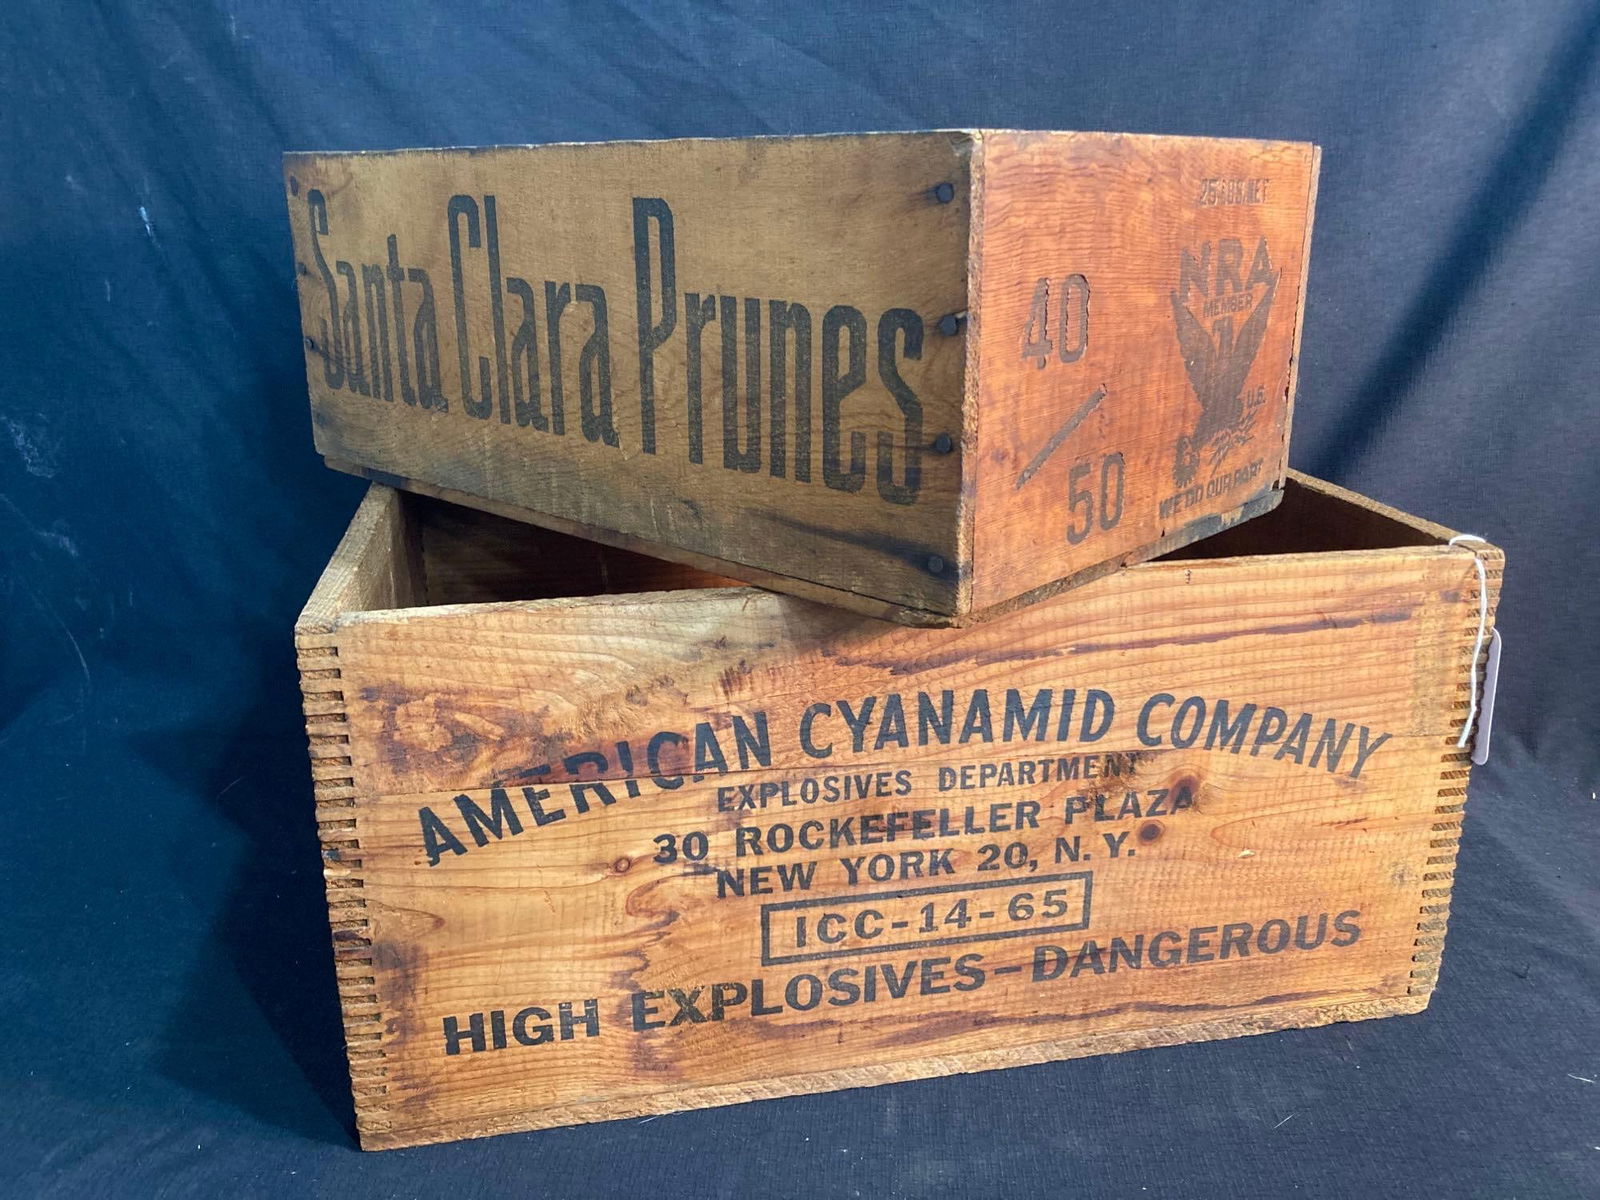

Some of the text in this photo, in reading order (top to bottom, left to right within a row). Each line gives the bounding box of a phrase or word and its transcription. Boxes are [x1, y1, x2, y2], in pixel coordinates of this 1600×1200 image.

[1200, 178, 1218, 205] 25
[1179, 234, 1274, 300] NRA
[1021, 273, 1090, 370] 40
[1203, 292, 1253, 318] MEMBER
[308, 188, 923, 504] Santa Clara Prunes
[1066, 451, 1125, 545] 50
[1207, 473, 1232, 499] OUR
[1233, 458, 1264, 488] PART
[417, 688, 1393, 867] AMERICAN CYANAMID COMPANY
[717, 753, 1138, 813] EXPLOSIVES DEPARTMENT
[653, 785, 1196, 864] 30 ROCKEFELLER PLAZA
[717, 861, 816, 899] NEW
[841, 847, 955, 886] YORK
[977, 842, 1039, 873] 20,
[795, 888, 1069, 948] ICC-14-65
[443, 998, 600, 1055] HIGH
